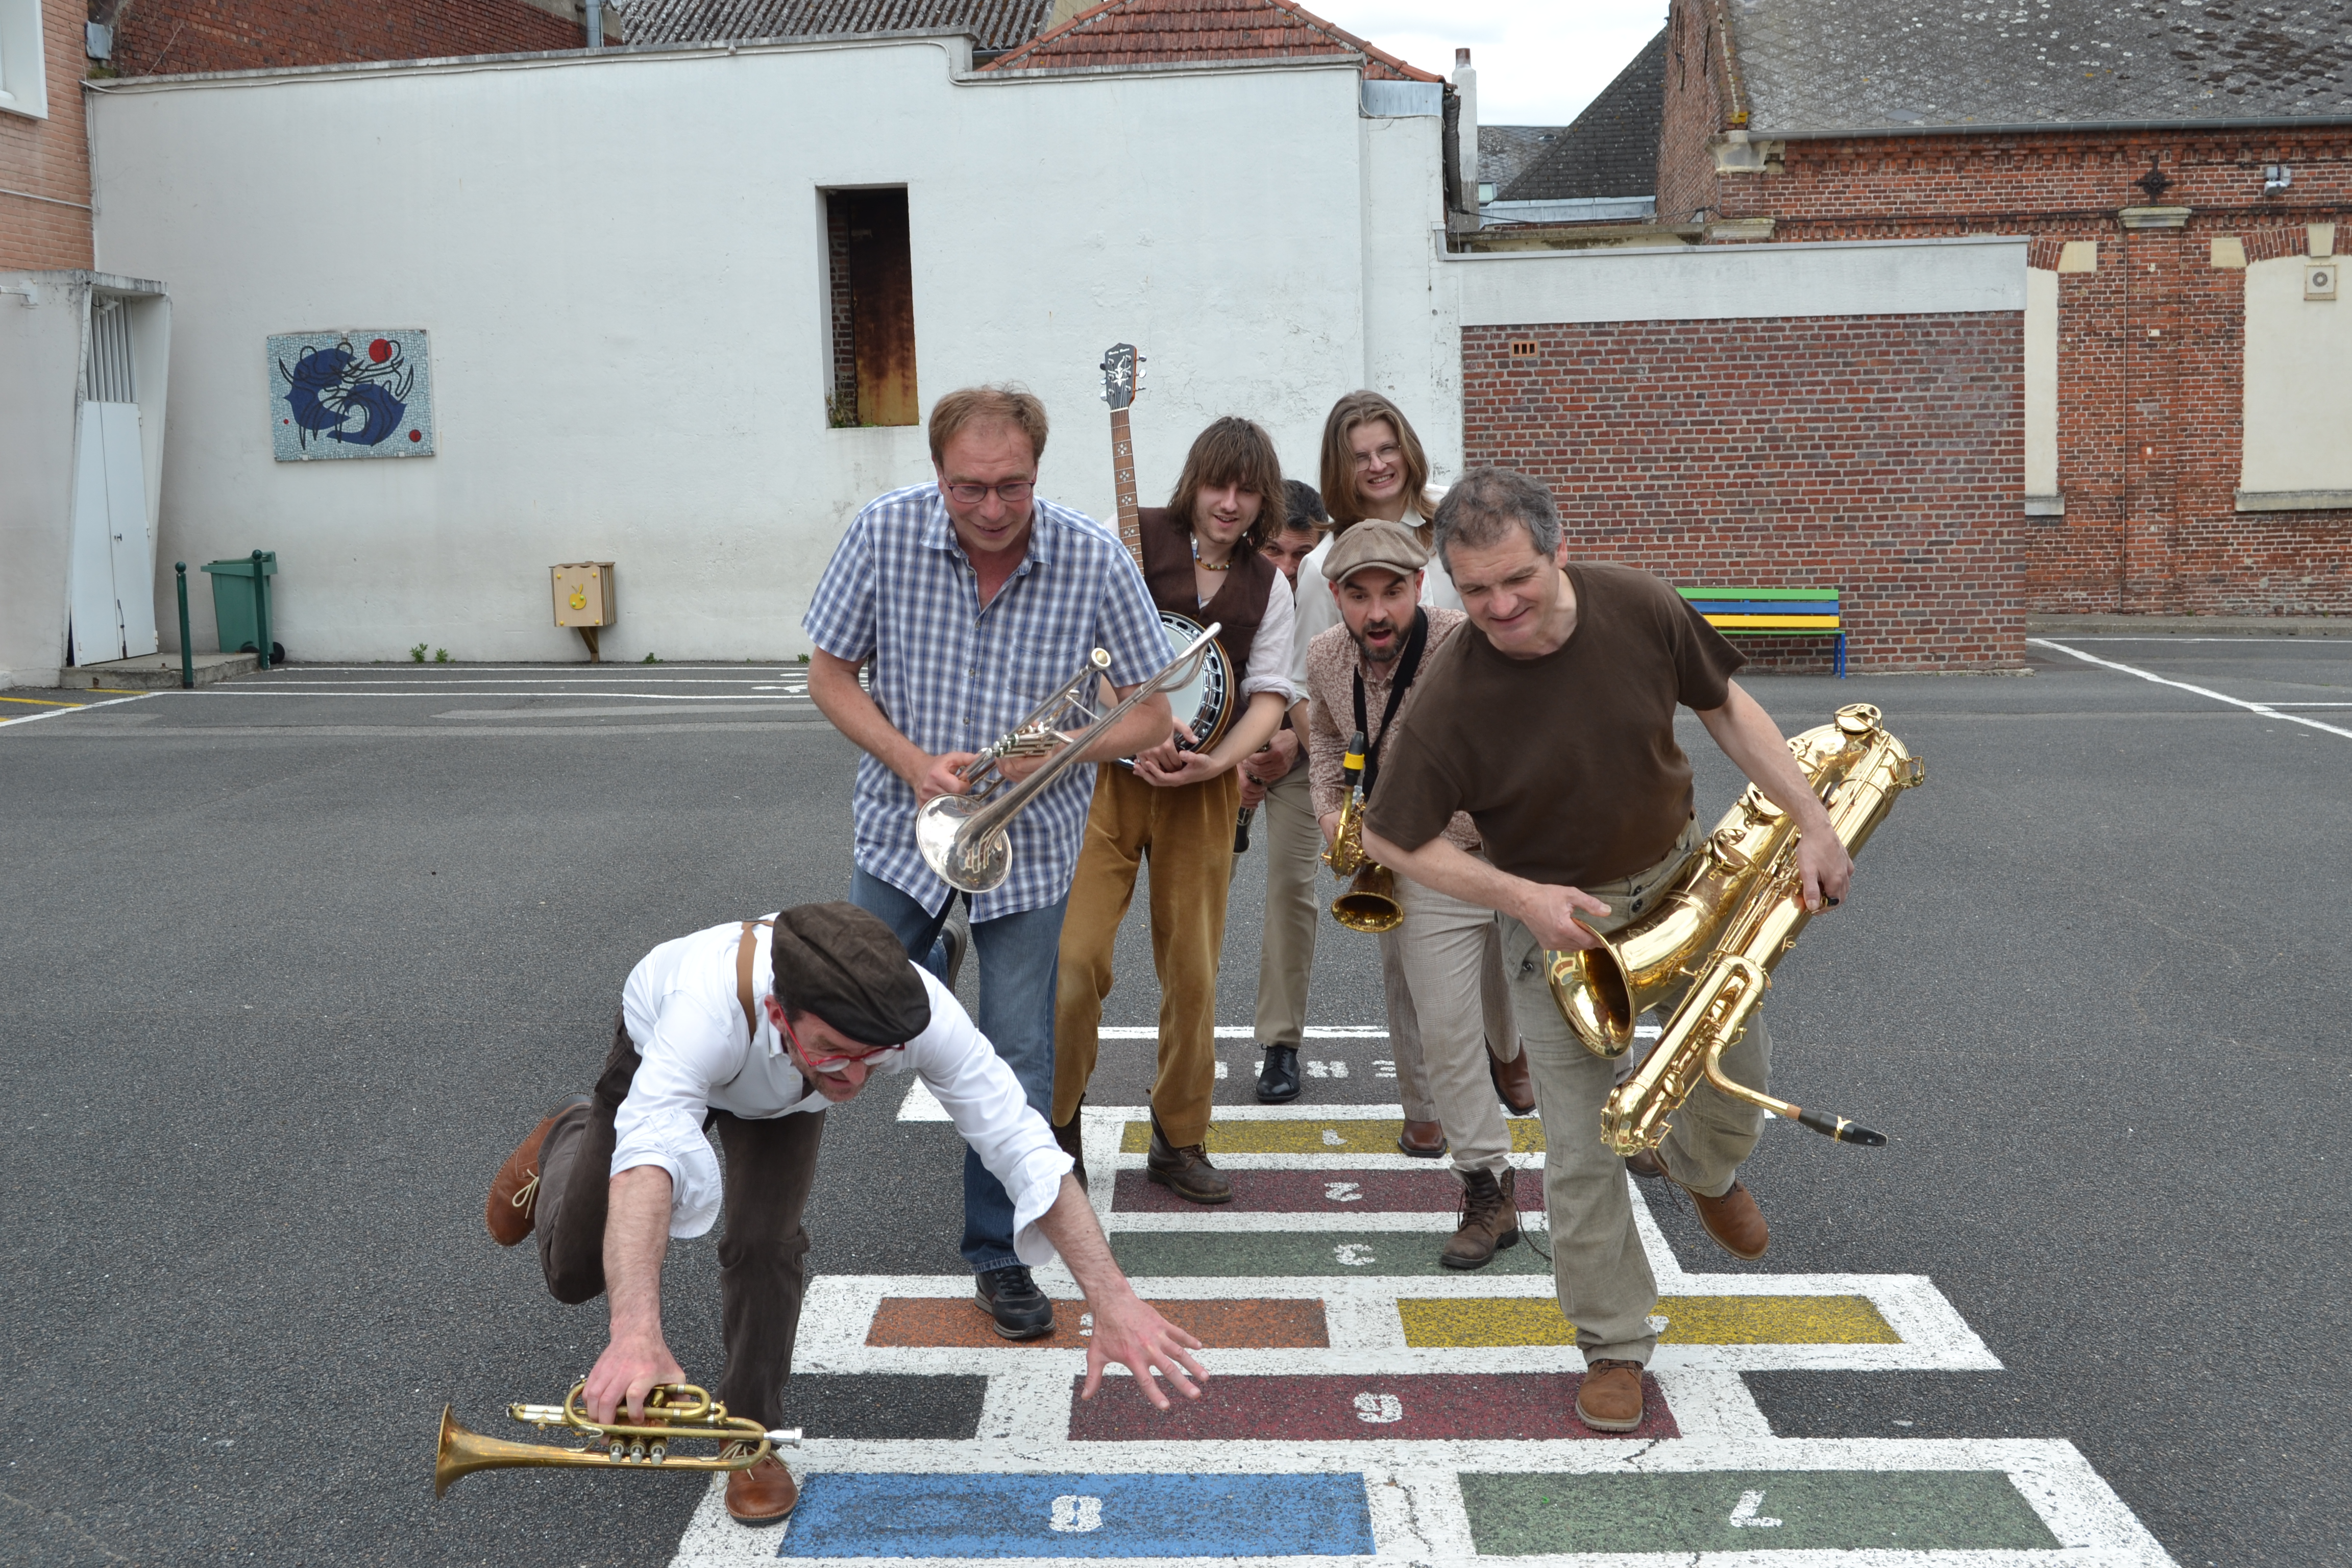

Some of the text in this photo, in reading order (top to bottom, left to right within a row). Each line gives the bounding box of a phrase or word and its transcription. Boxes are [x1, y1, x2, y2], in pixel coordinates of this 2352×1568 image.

[1325, 1182, 1362, 1202] 2
[1334, 1243, 1376, 1266] 3
[1049, 1495, 1103, 1533] 8
[1729, 1489, 1783, 1528] 7
